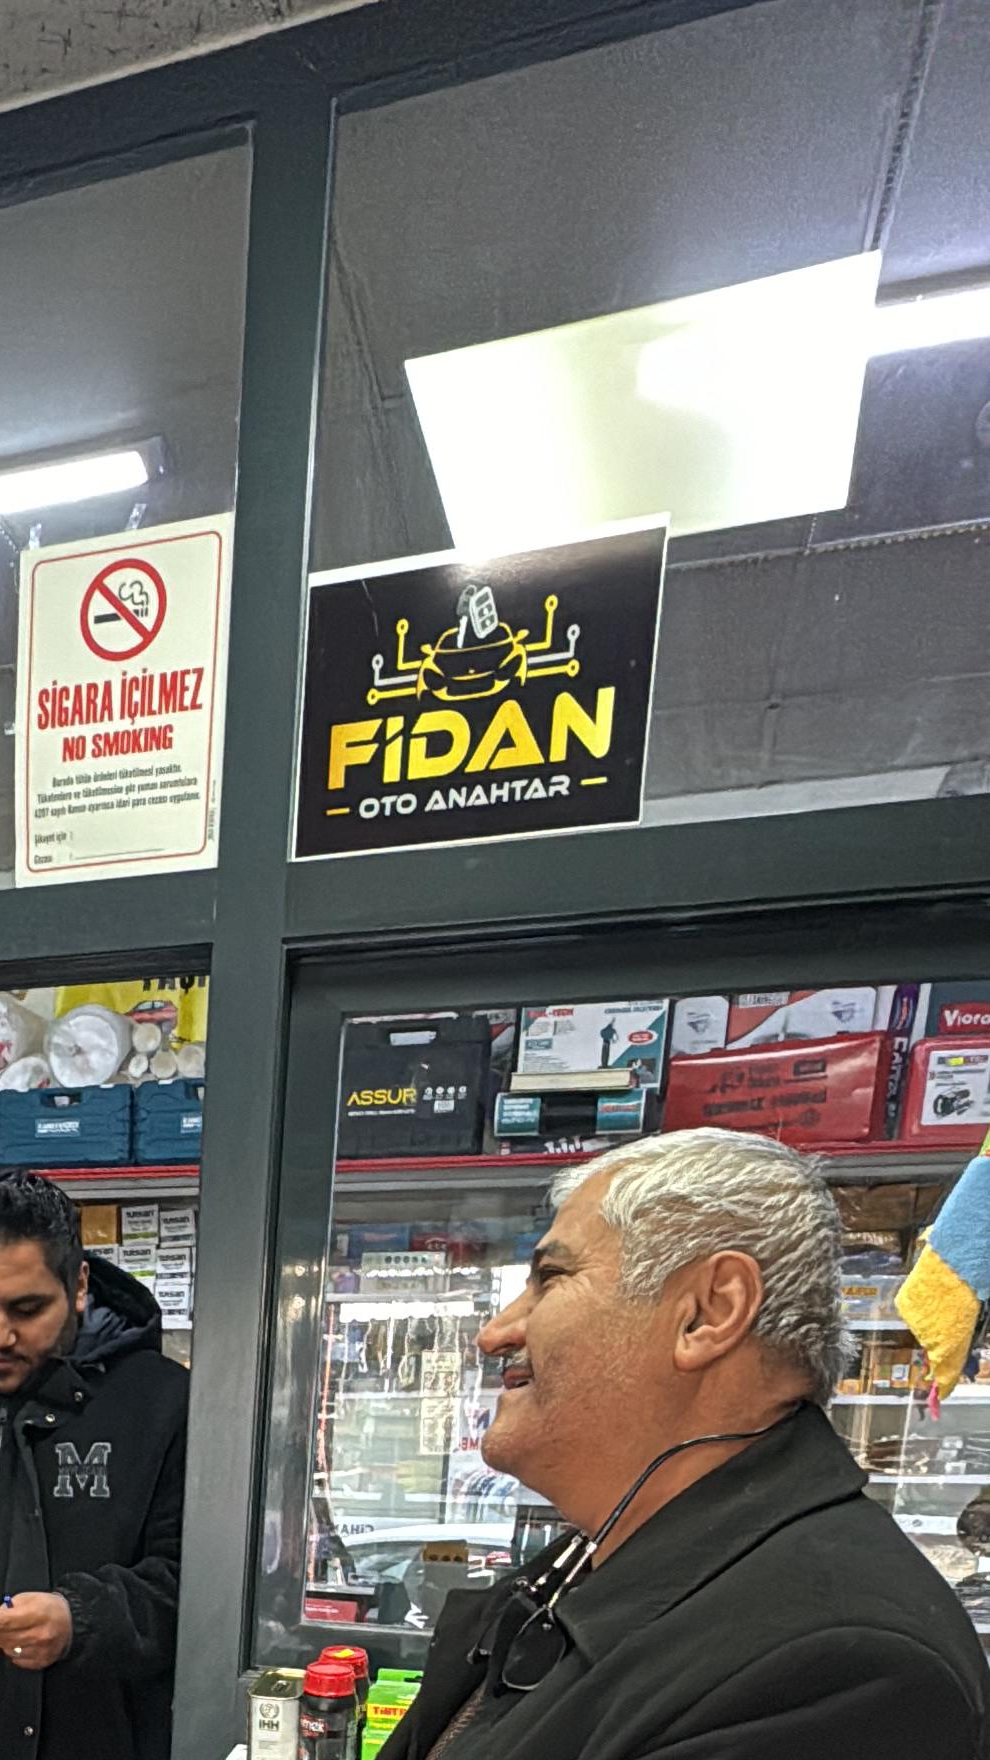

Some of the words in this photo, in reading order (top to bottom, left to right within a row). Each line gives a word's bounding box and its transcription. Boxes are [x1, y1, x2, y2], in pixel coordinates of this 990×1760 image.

[37, 680, 113, 730] SİGARA
[120, 666, 205, 725] İÇİLMEZ
[62, 735, 87, 763] NO
[91, 724, 174, 759] SMOKING
[358, 793, 417, 819] OTO
[424, 774, 571, 813] ANAHTAR
[53, 1442, 112, 1497] M
